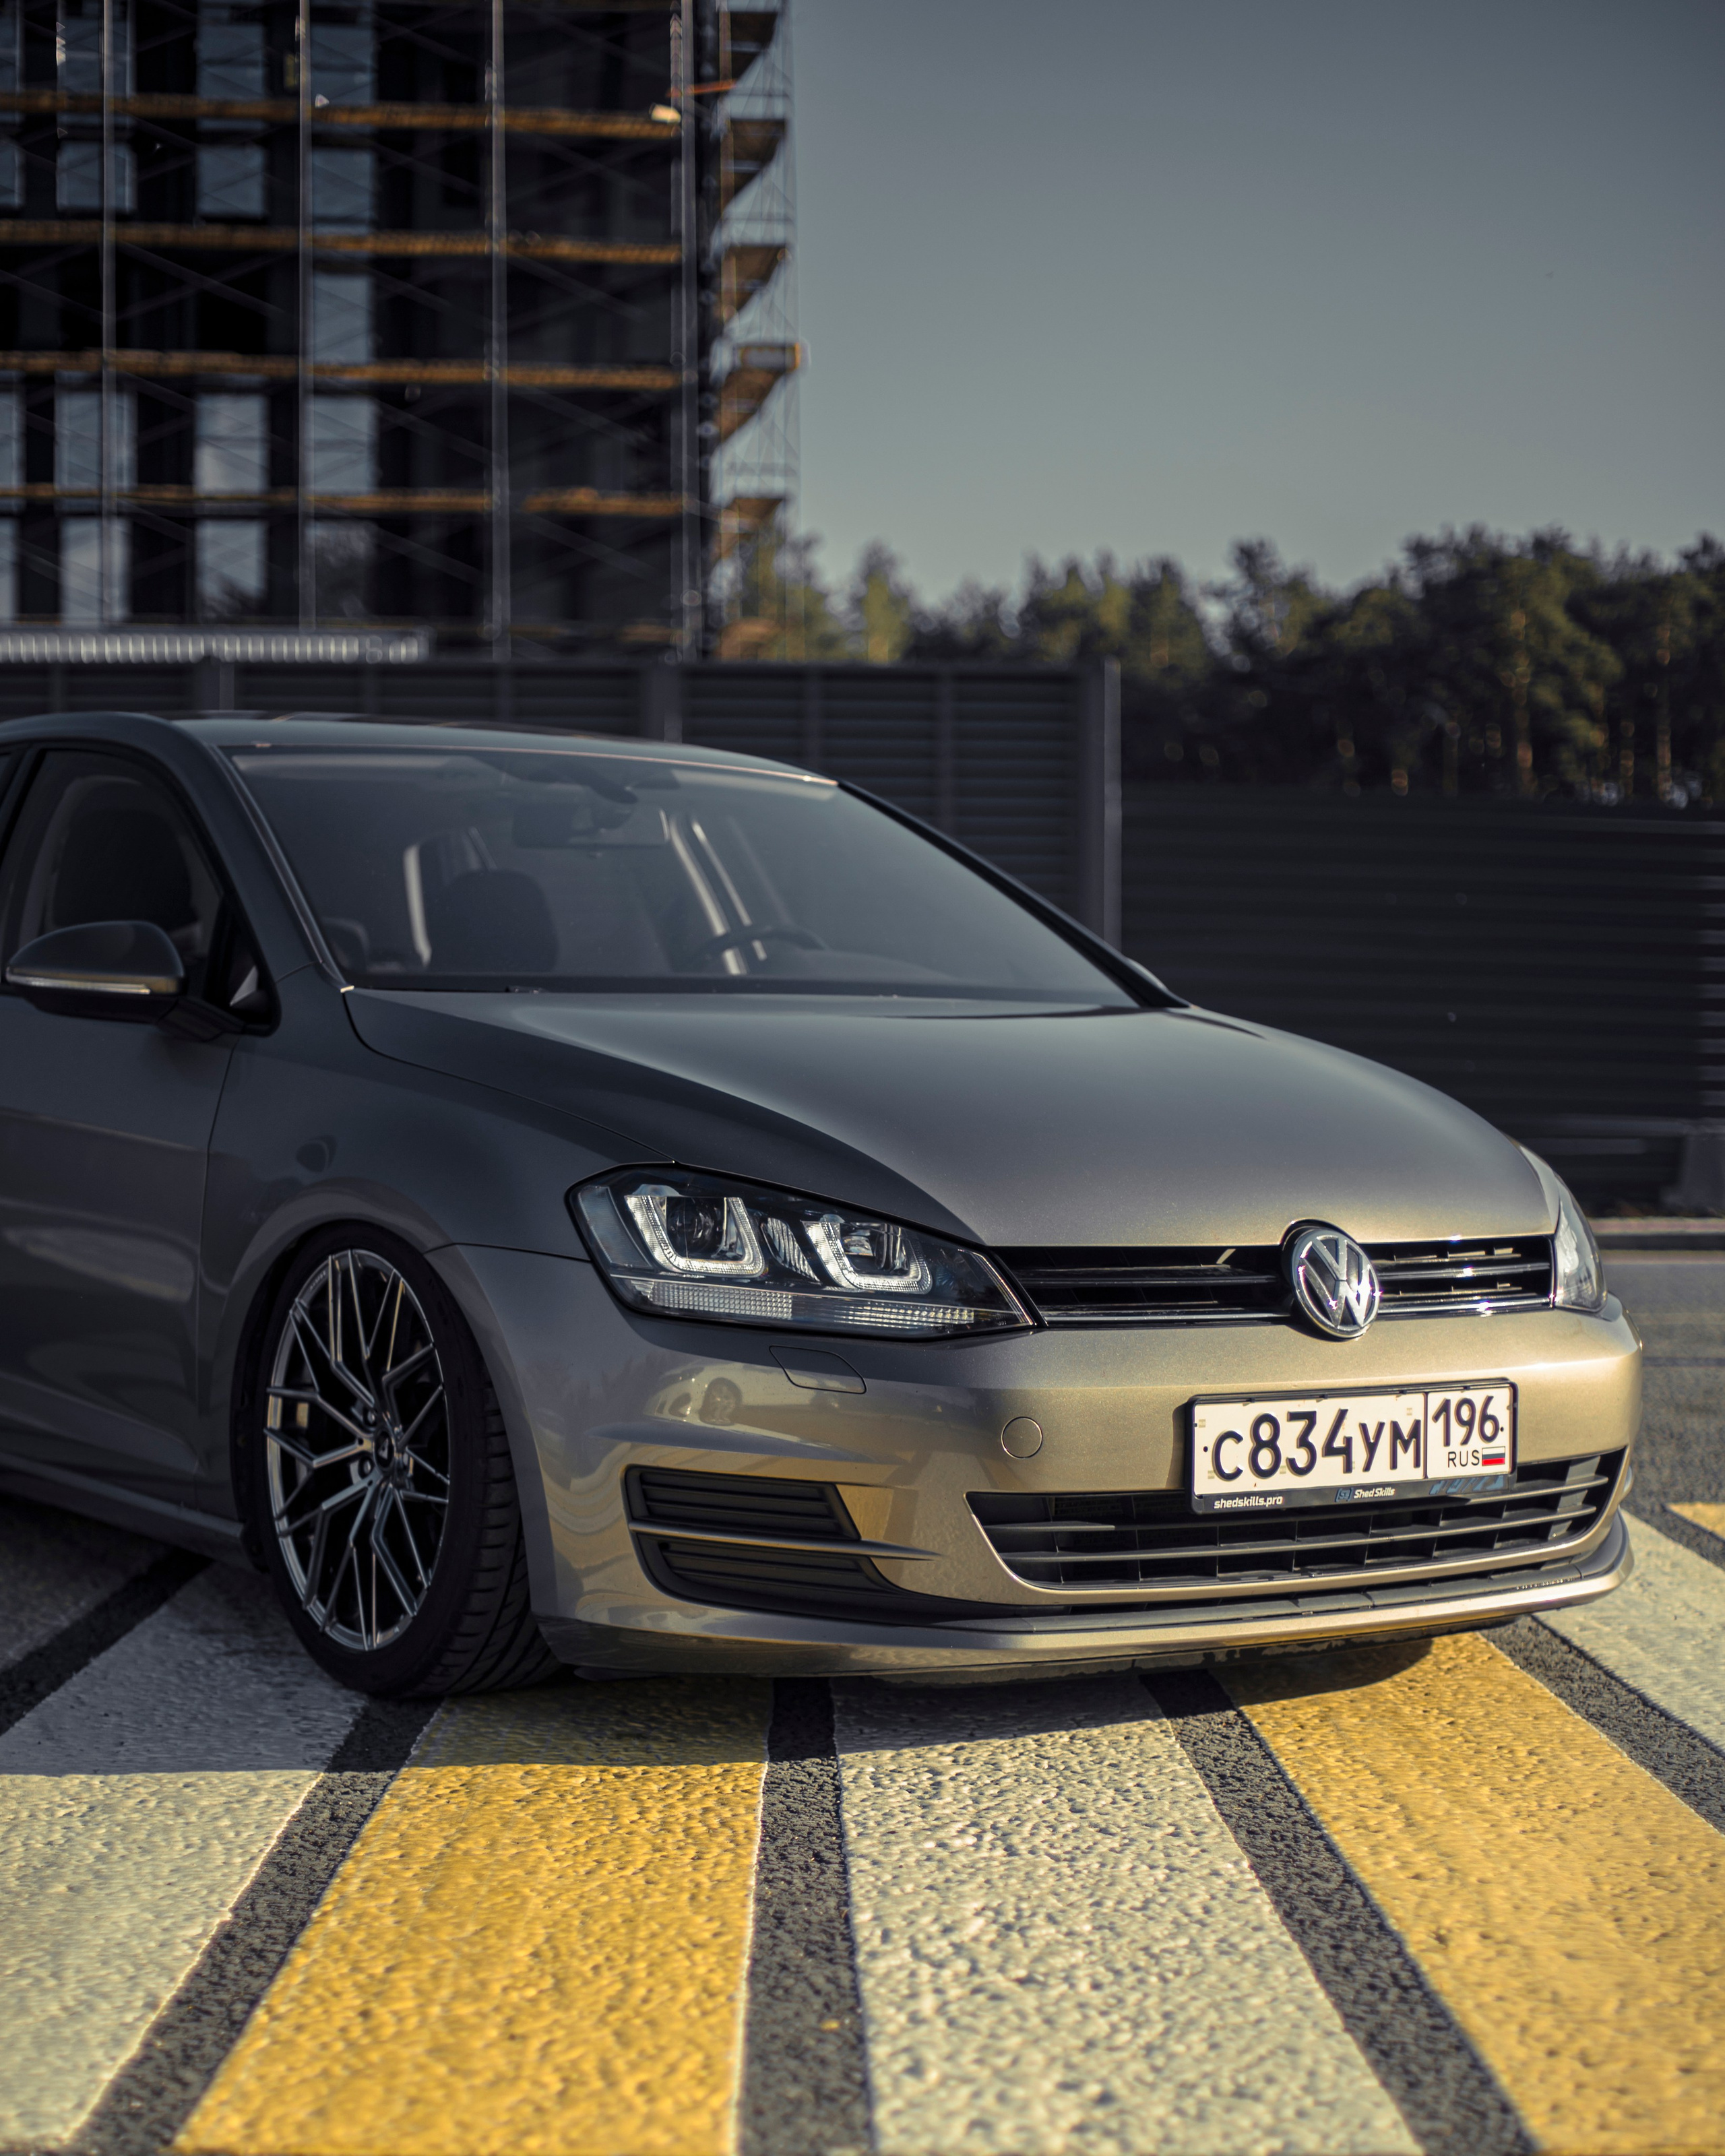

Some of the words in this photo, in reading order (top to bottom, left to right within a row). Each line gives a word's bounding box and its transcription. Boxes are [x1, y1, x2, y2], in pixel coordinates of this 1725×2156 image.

[1432, 1395, 1500, 1447] 196
[1447, 1449, 1480, 1468] RUS
[1214, 1496, 1283, 1509] shedskills.pro
